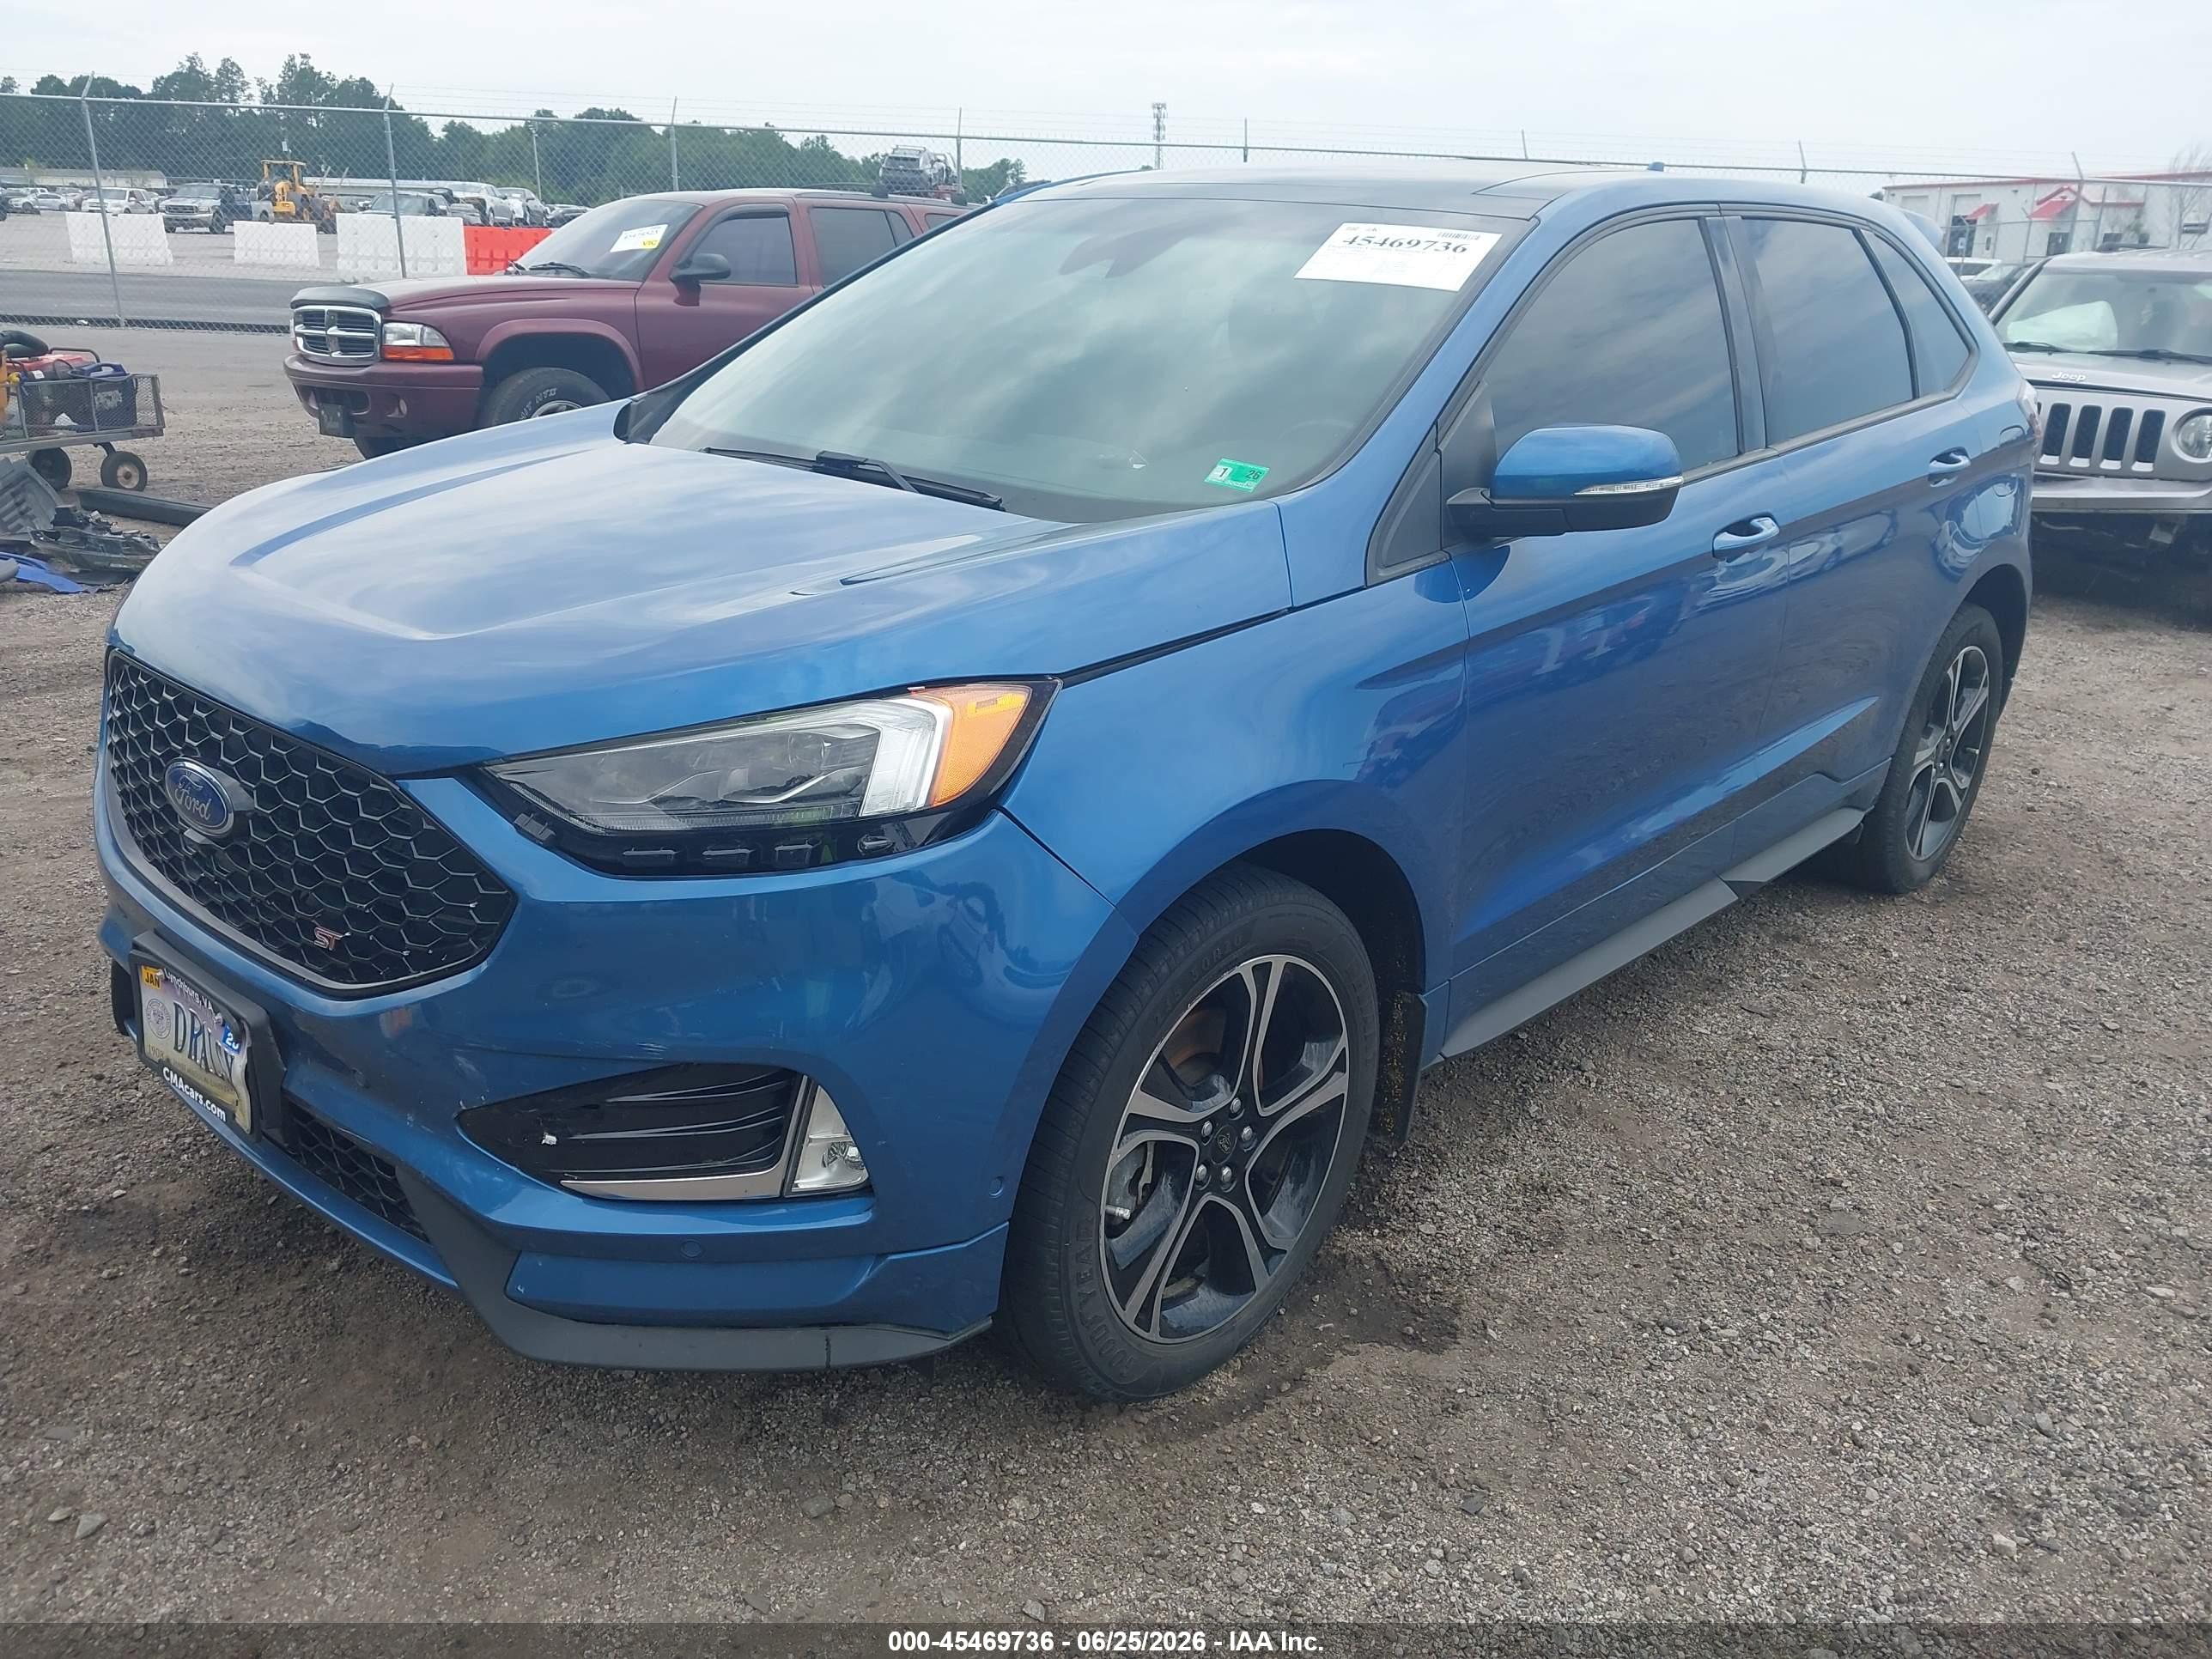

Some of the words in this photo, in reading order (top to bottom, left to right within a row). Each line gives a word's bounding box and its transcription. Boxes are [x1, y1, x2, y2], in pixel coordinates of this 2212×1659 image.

[1342, 234, 1468, 254] 45469736
[2051, 371, 2087, 382] Jeep
[1245, 470, 1262, 480] 26
[174, 775, 212, 820] Ford
[313, 927, 343, 951] ST
[144, 971, 161, 988] JAN
[164, 968, 202, 1006] Lynchburg,
[201, 995, 214, 1012] VA
[162, 1066, 227, 1121] CMAcars.com
